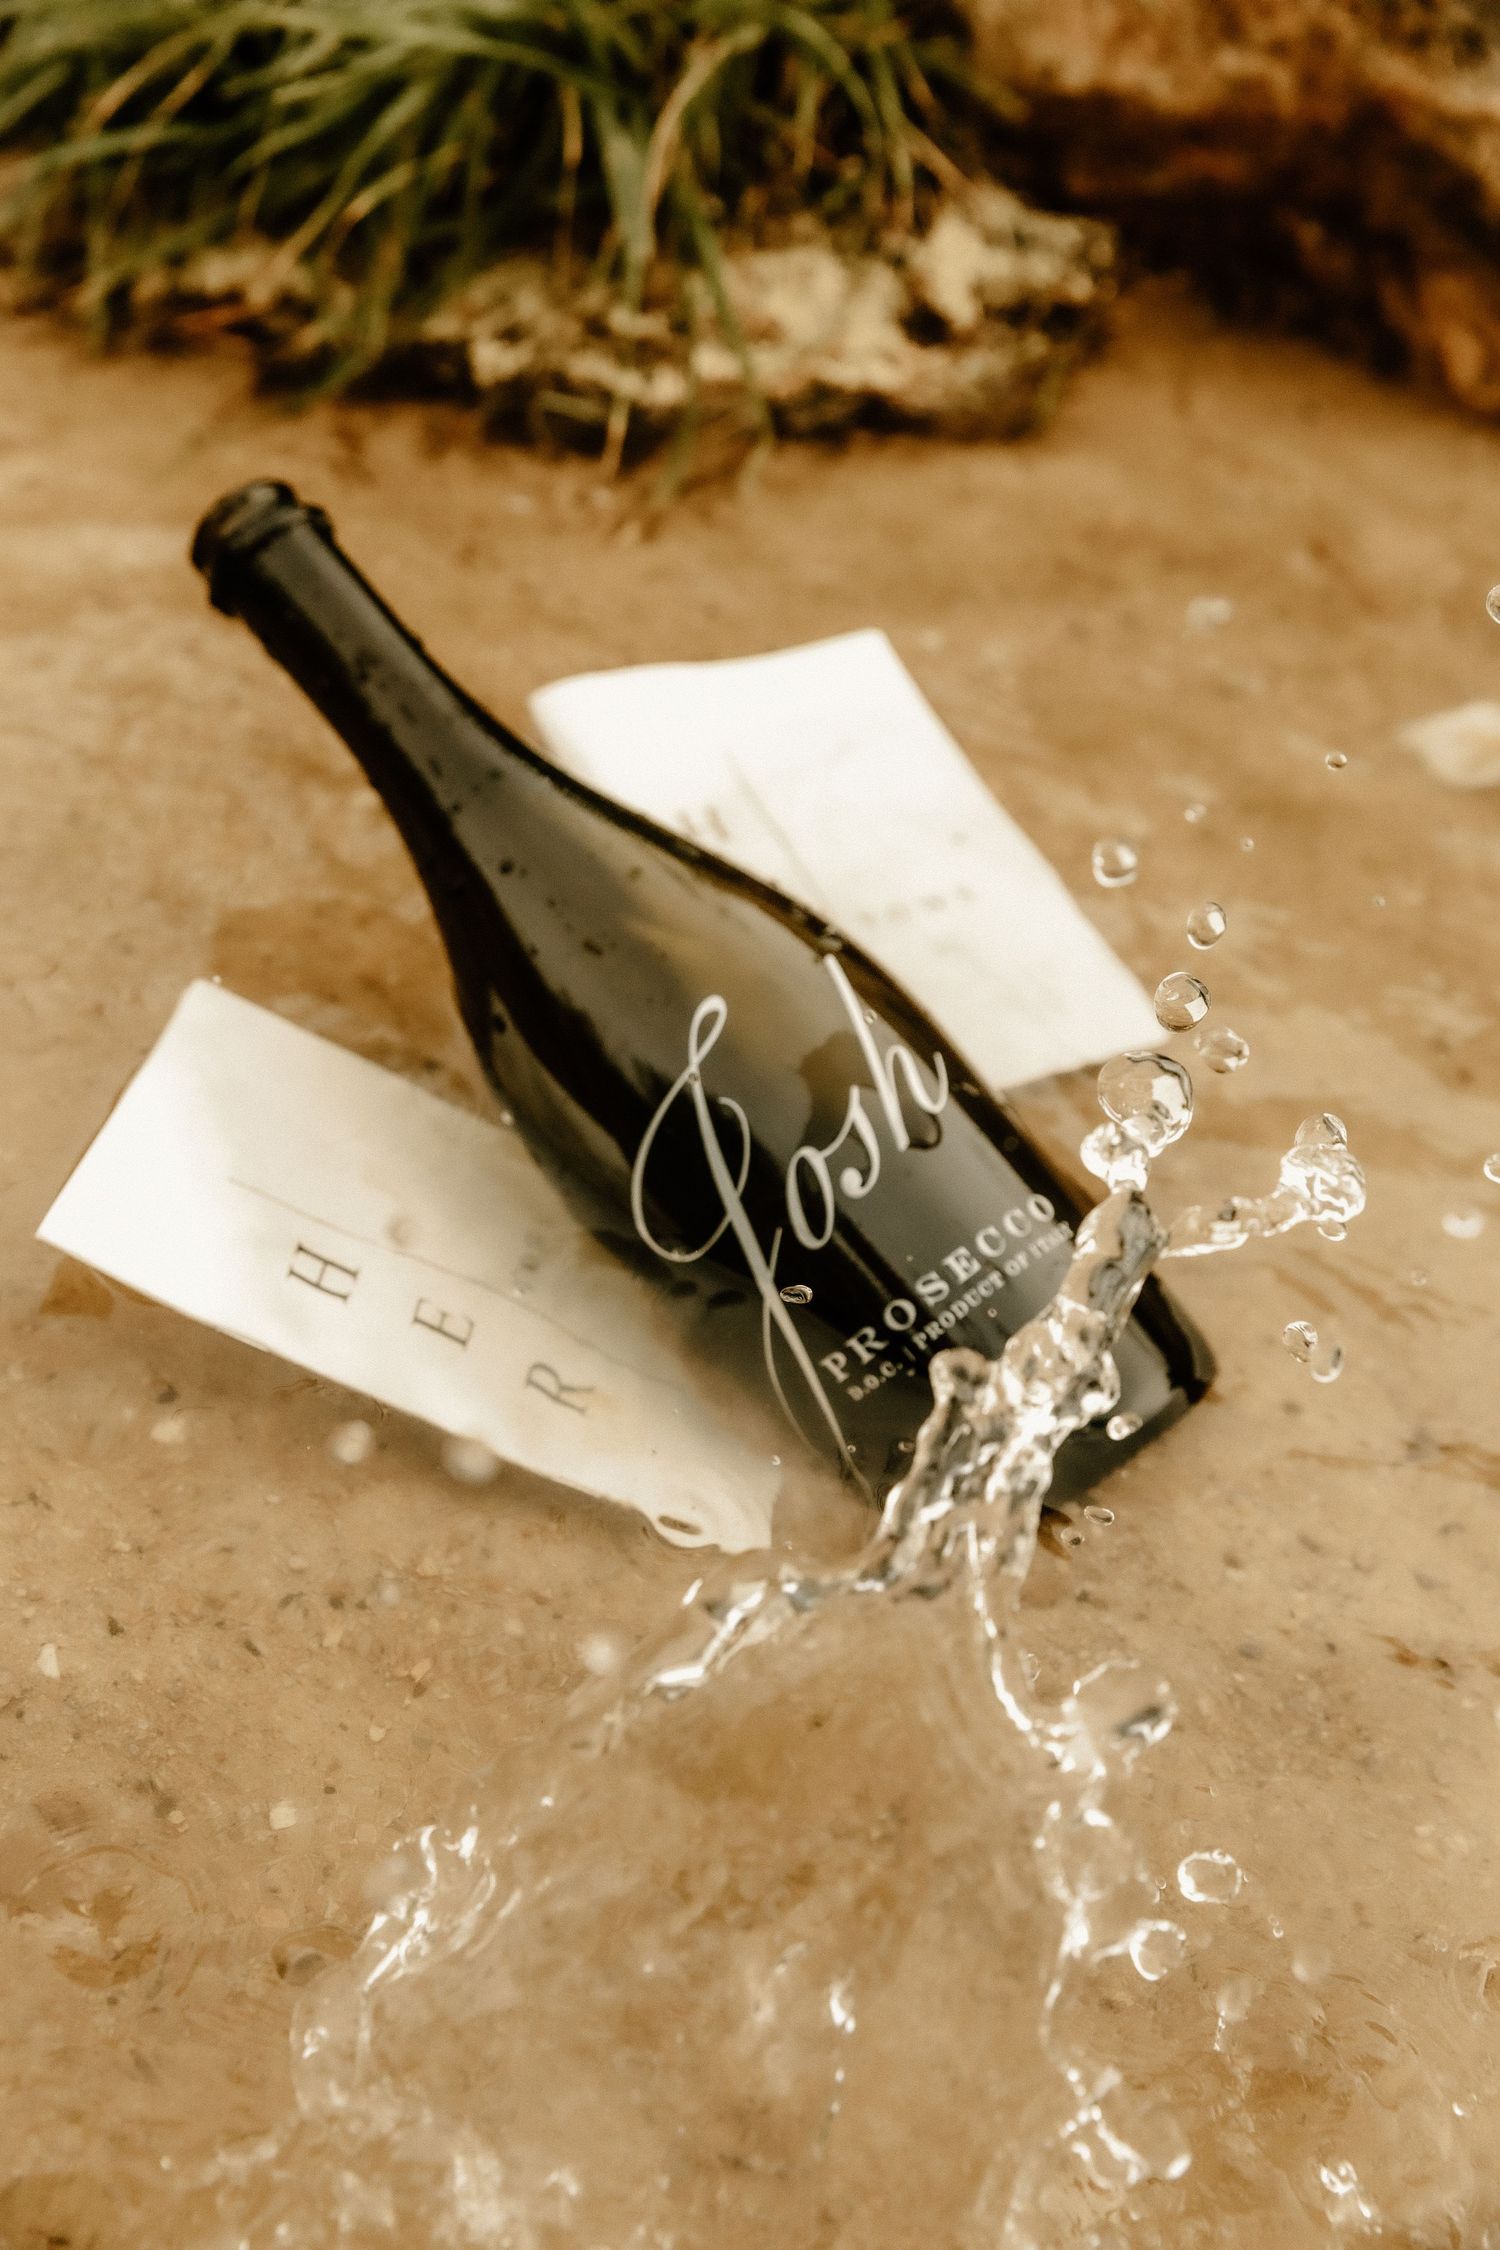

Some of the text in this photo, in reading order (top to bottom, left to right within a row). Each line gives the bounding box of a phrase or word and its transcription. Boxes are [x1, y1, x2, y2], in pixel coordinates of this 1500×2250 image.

[631, 955, 950, 1504] Josh
[819, 1193, 1055, 1383] PROSECCO
[911, 1270, 1005, 1350] PRODUCT
[1003, 1251, 1029, 1277] OF
